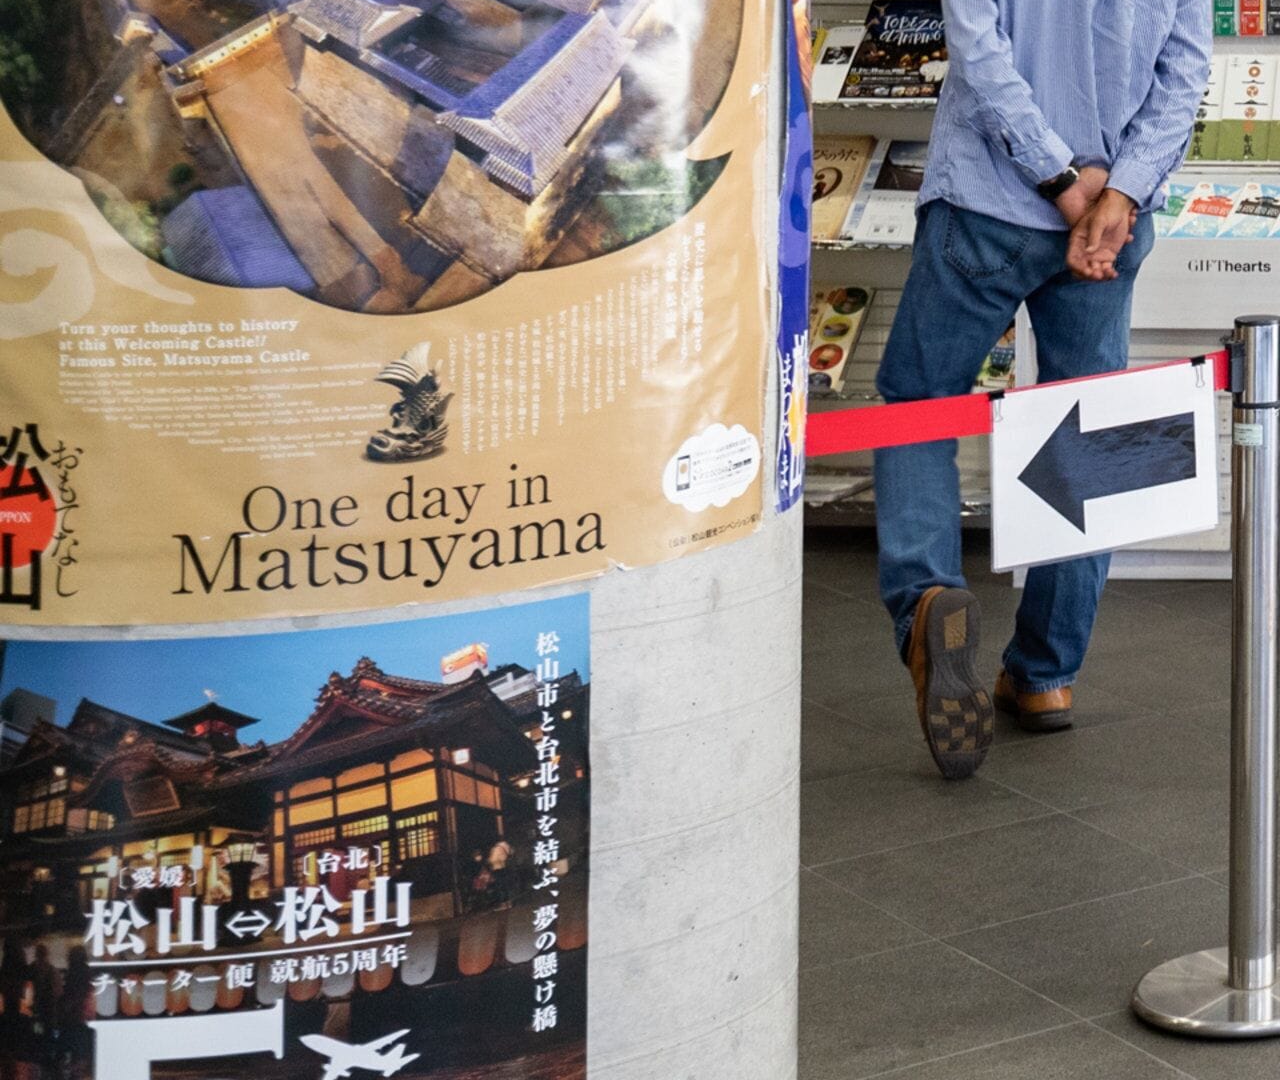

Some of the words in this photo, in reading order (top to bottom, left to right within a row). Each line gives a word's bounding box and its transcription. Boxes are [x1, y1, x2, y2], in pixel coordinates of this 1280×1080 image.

[1188, 259, 1272, 274] GIFThearts
[58, 340, 75, 351] at
[78, 338, 107, 351] this
[113, 337, 200, 352] Welcoming
[59, 322, 95, 335] Turn
[102, 323, 137, 337] your
[143, 321, 212, 335] thoughts
[218, 322, 235, 332] to
[240, 318, 299, 335] history
[59, 354, 115, 368] Famous
[163, 353, 252, 367] Matsuyama
[259, 350, 310, 363] Castle
[51, 440, 84, 598] おもてなし
[242, 484, 360, 533] One
[385, 476, 486, 526] day
[507, 463, 553, 509] in
[171, 510, 608, 597] Matsuyama
[533, 630, 561, 1032] 松山市と台北市を結ぶ、夢の懸け橋
[83, 896, 220, 957] 松山
[274, 876, 413, 944] 松山
[91, 963, 255, 996] チャーター便
[270, 942, 409, 986] 就航5周年
